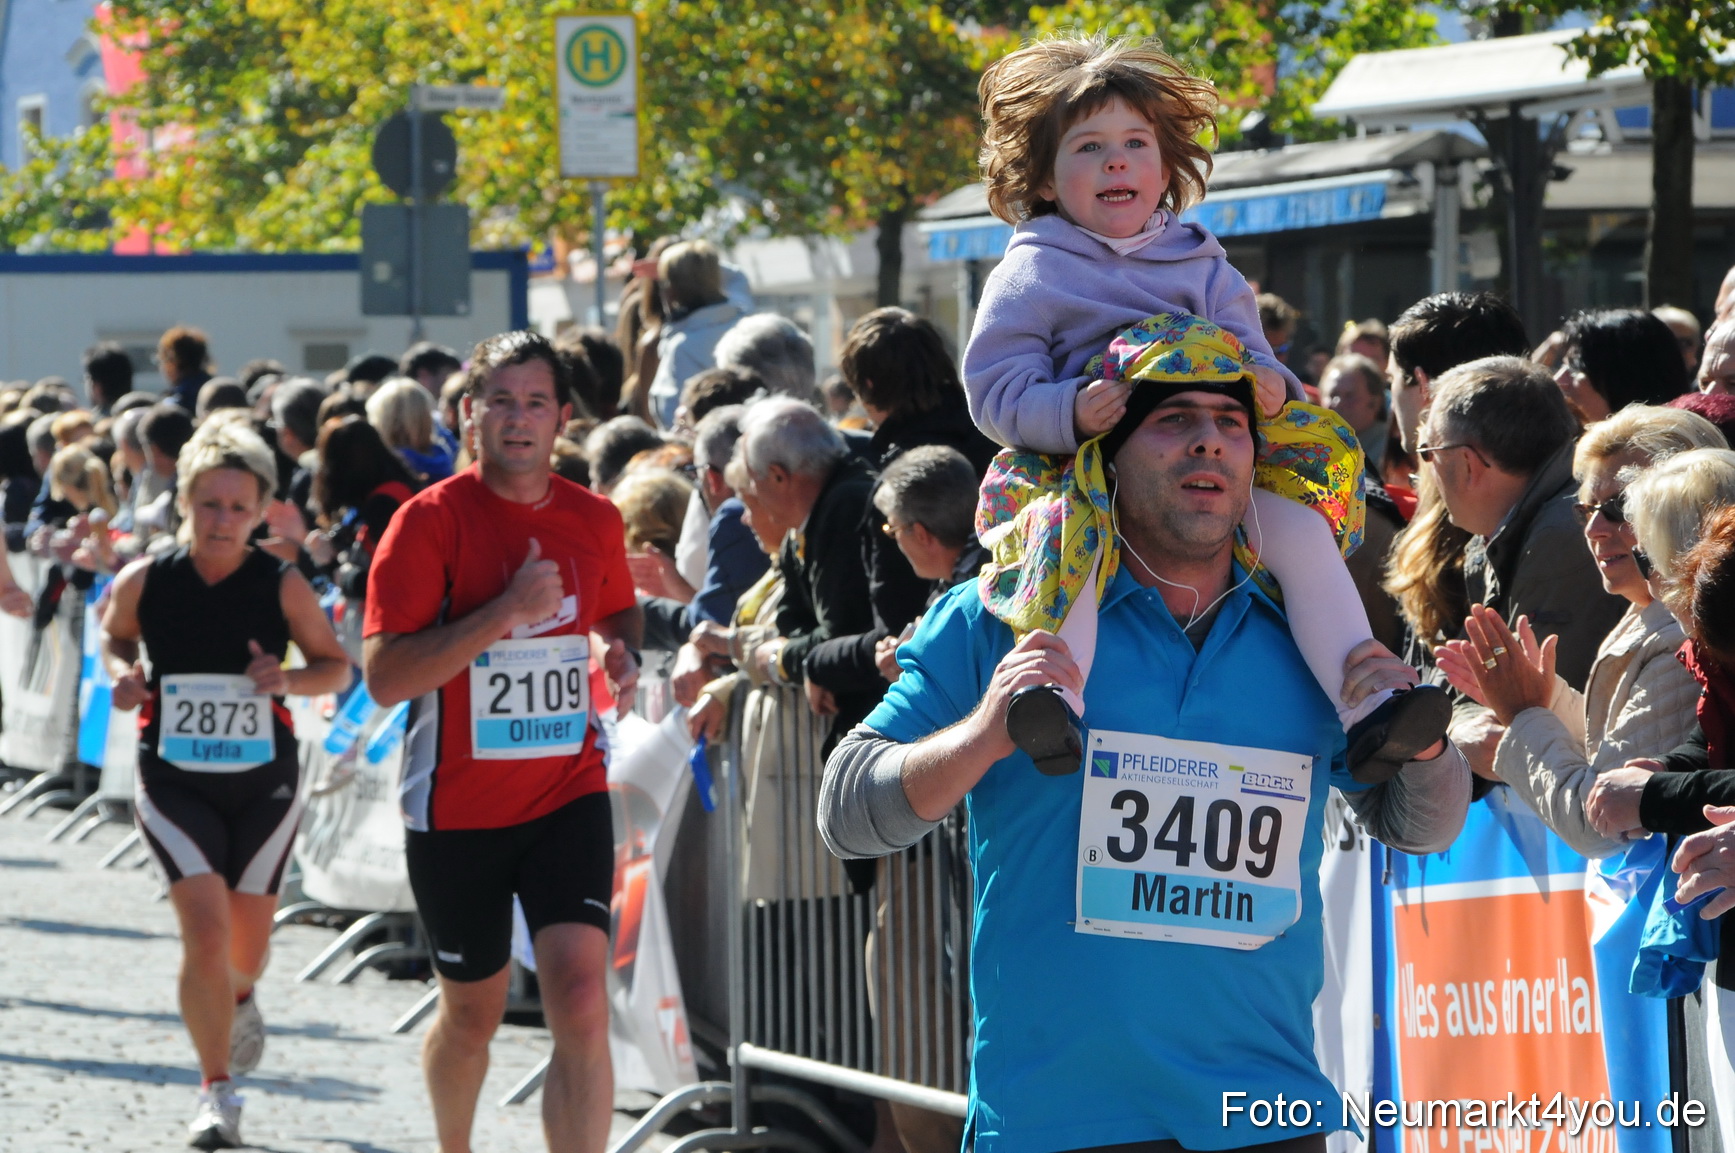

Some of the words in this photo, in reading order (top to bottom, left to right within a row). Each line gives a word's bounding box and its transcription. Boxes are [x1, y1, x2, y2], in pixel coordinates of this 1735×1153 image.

[582, 39, 611, 73] H
[488, 667, 581, 715] 2109
[175, 700, 258, 736] 2873
[509, 719, 572, 743] Oliver
[191, 739, 242, 761] Lydia
[1122, 753, 1219, 780] PFLEIDERER
[1120, 772, 1220, 791] AKTIENGESELLSCHAFT
[1241, 771, 1295, 792] BOCK
[1106, 788, 1283, 879] 3409
[1131, 872, 1254, 923] Martin
[1445, 979, 1499, 1037] aus
